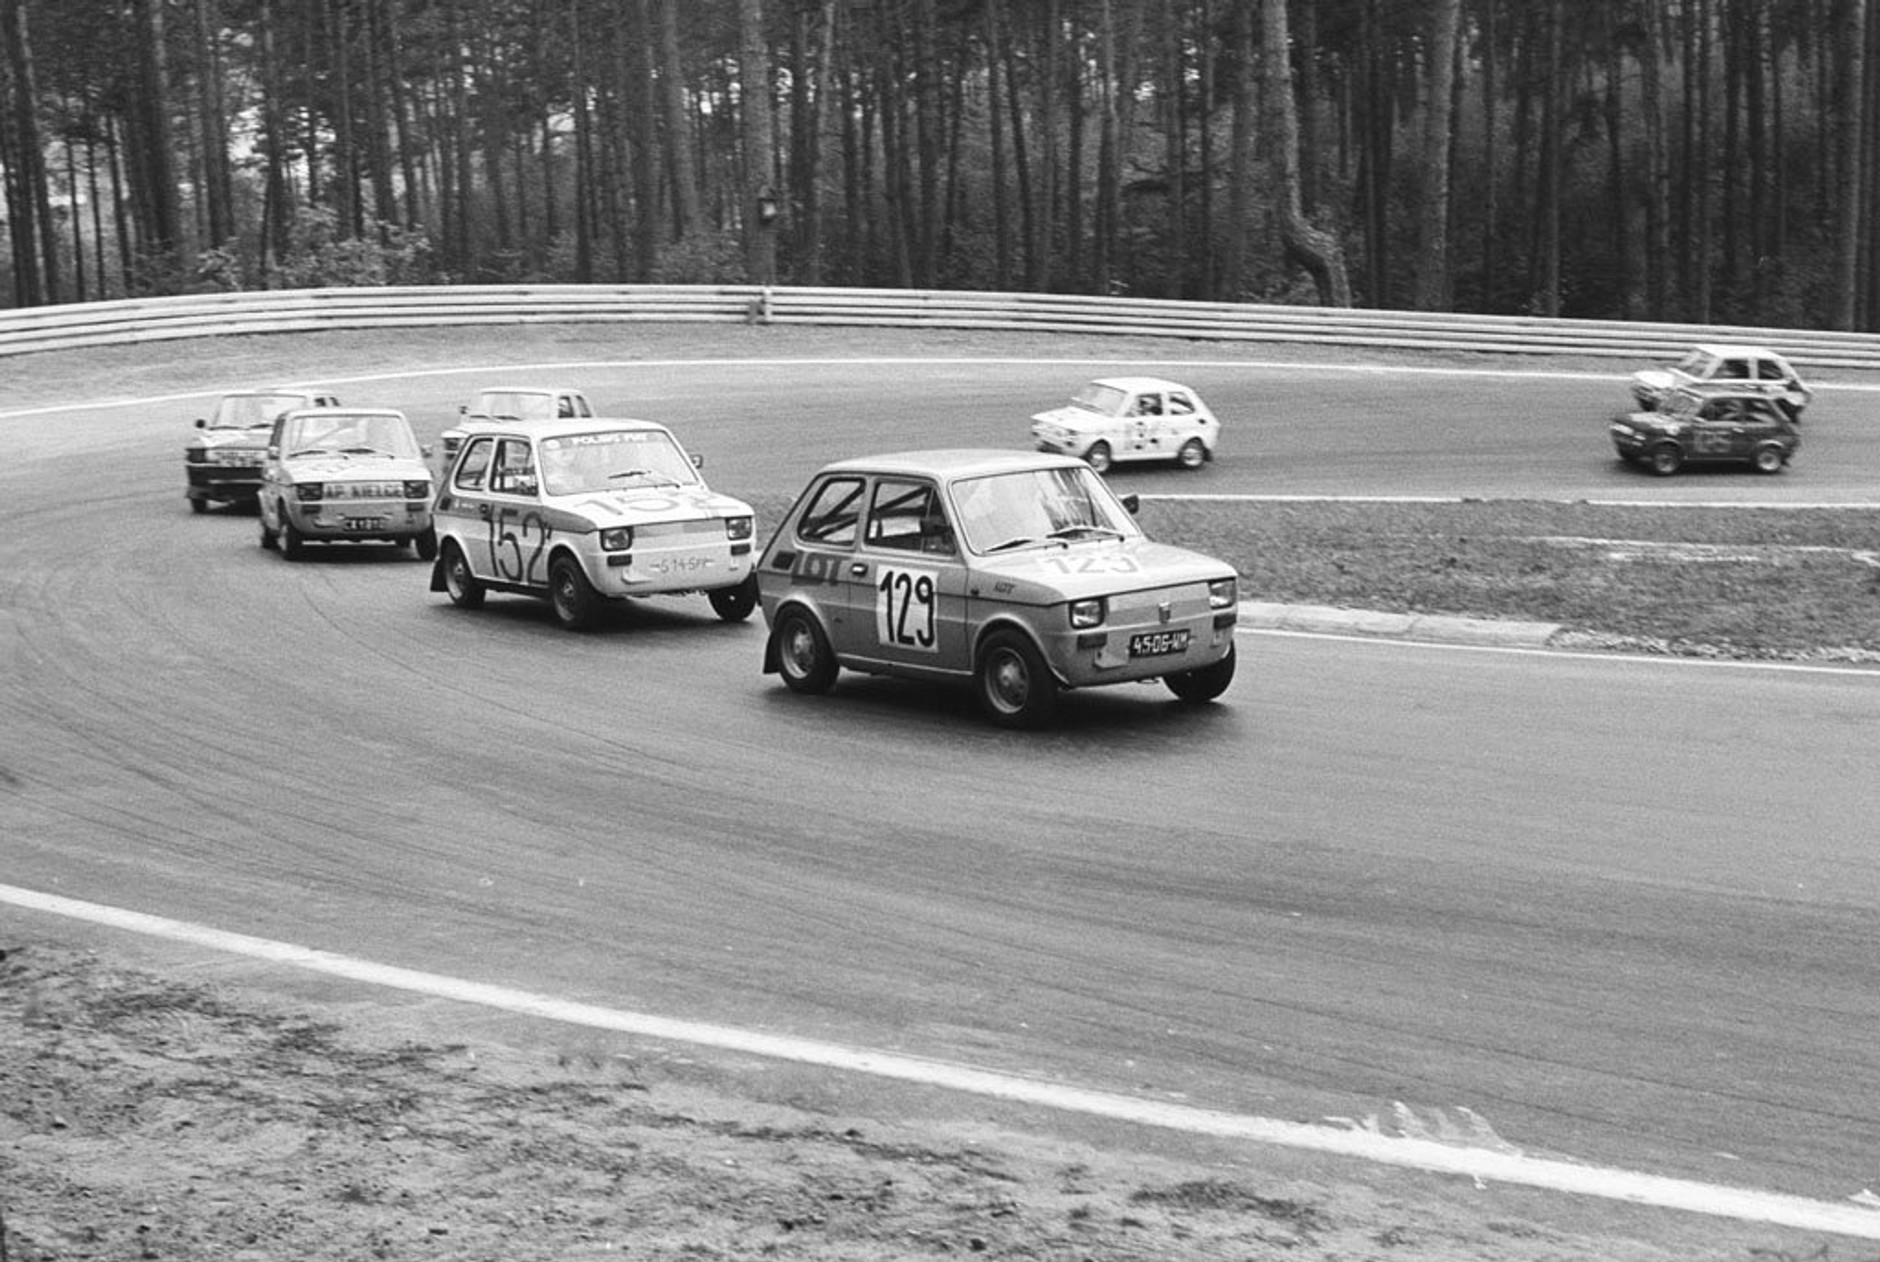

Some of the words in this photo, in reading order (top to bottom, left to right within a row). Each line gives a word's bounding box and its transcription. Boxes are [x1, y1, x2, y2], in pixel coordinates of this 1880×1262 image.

[482, 503, 549, 585] 152
[791, 550, 852, 586] LOT
[879, 571, 935, 648] 129
